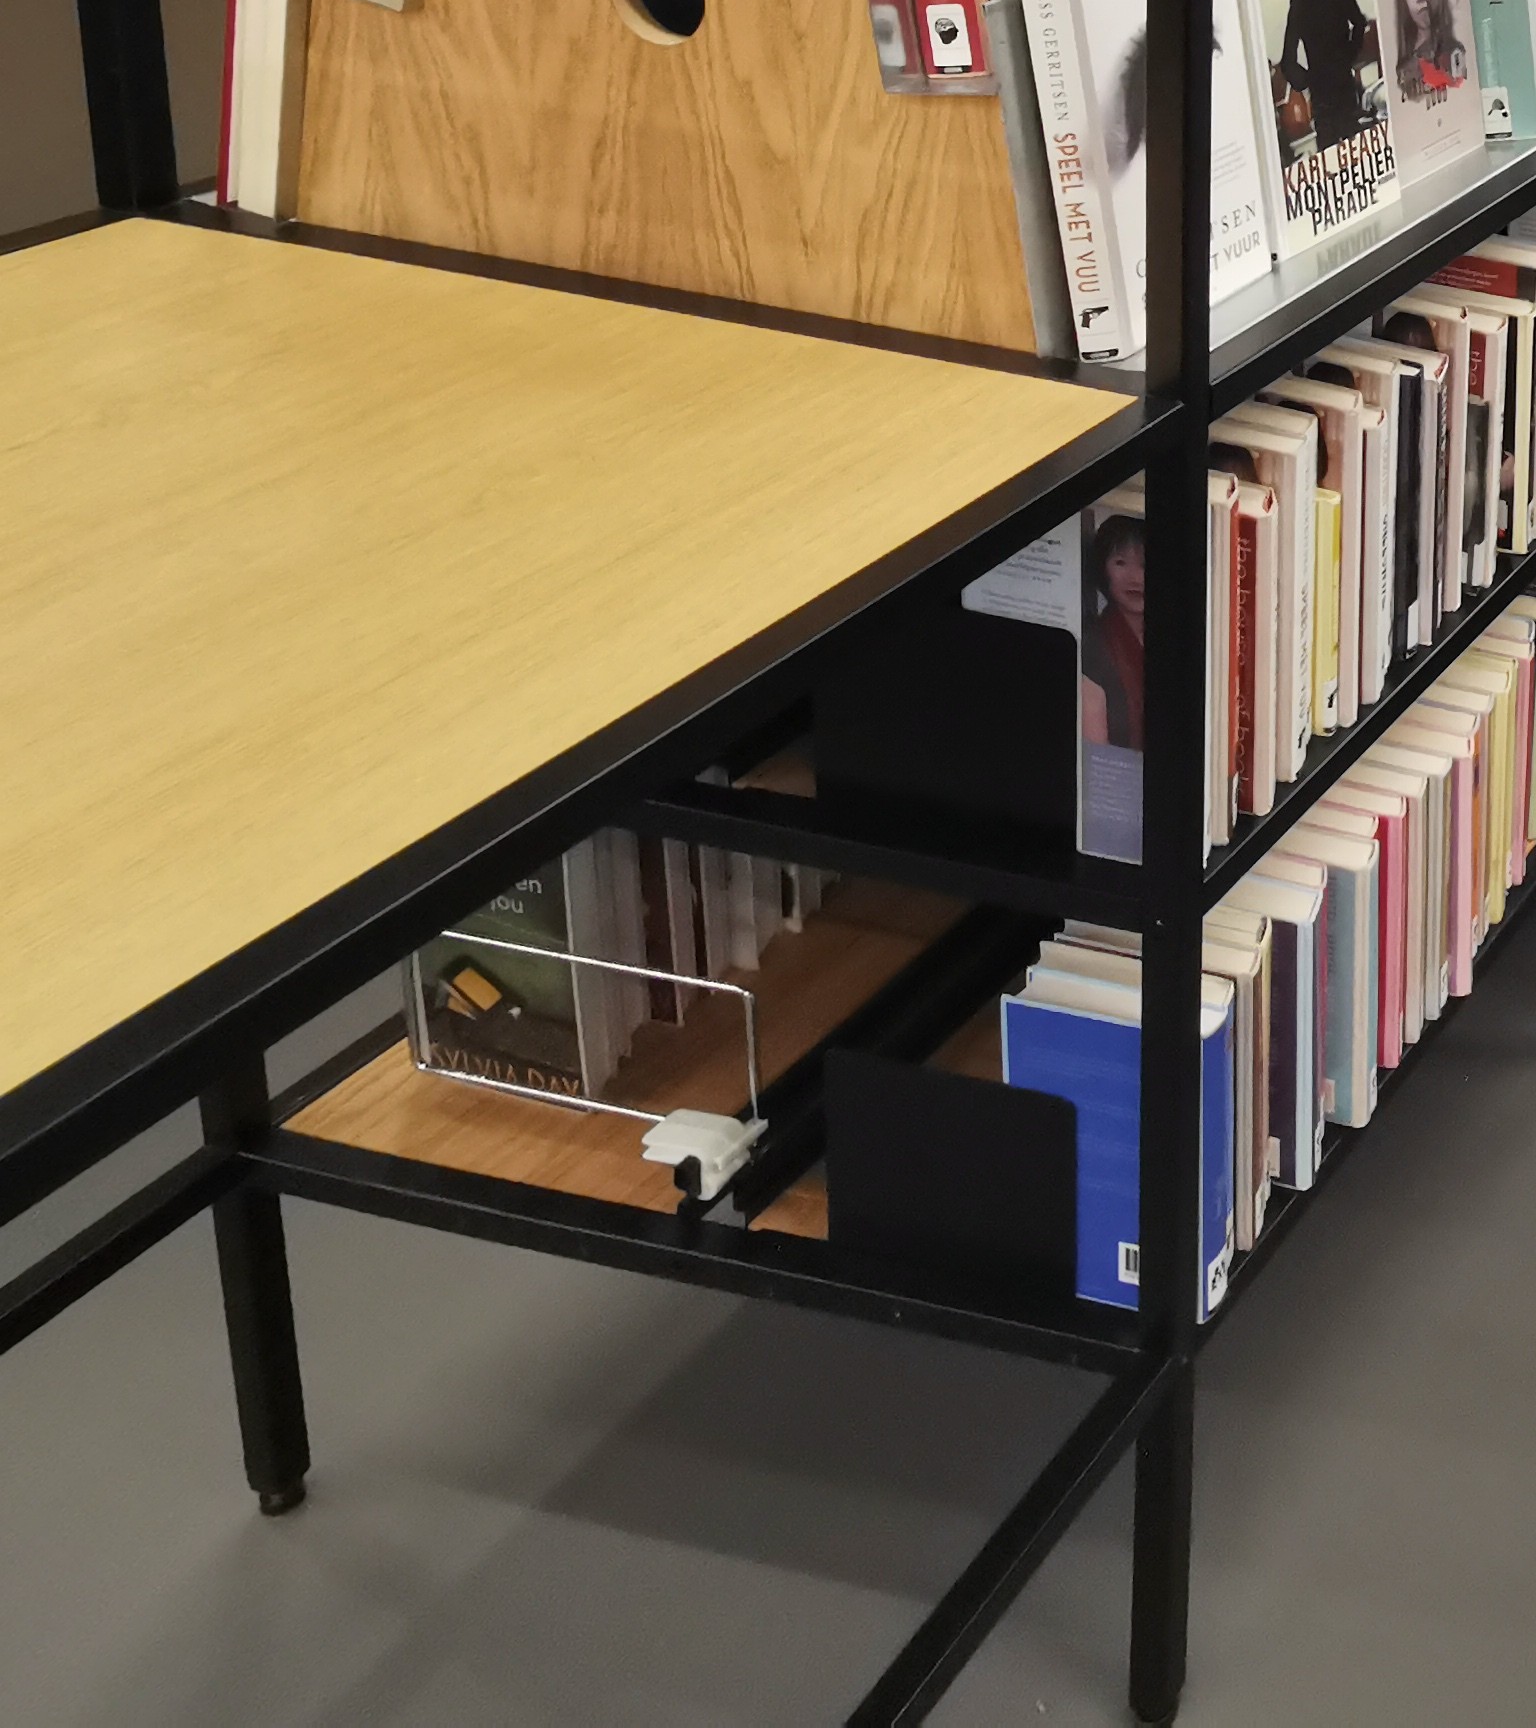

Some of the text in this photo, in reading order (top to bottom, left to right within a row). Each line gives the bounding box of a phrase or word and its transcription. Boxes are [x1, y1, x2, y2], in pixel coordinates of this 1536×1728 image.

[1042, 28, 1069, 122] GERRITSEN
[1053, 132, 1084, 194] SPEEL
[1283, 119, 1389, 194] KARL GEARY
[1286, 145, 1396, 222] MONTPELIER
[1065, 202, 1093, 244] MET
[1311, 180, 1379, 237] PARADE
[1075, 250, 1101, 294] VUU
[1221, 229, 1262, 263] VUUR
